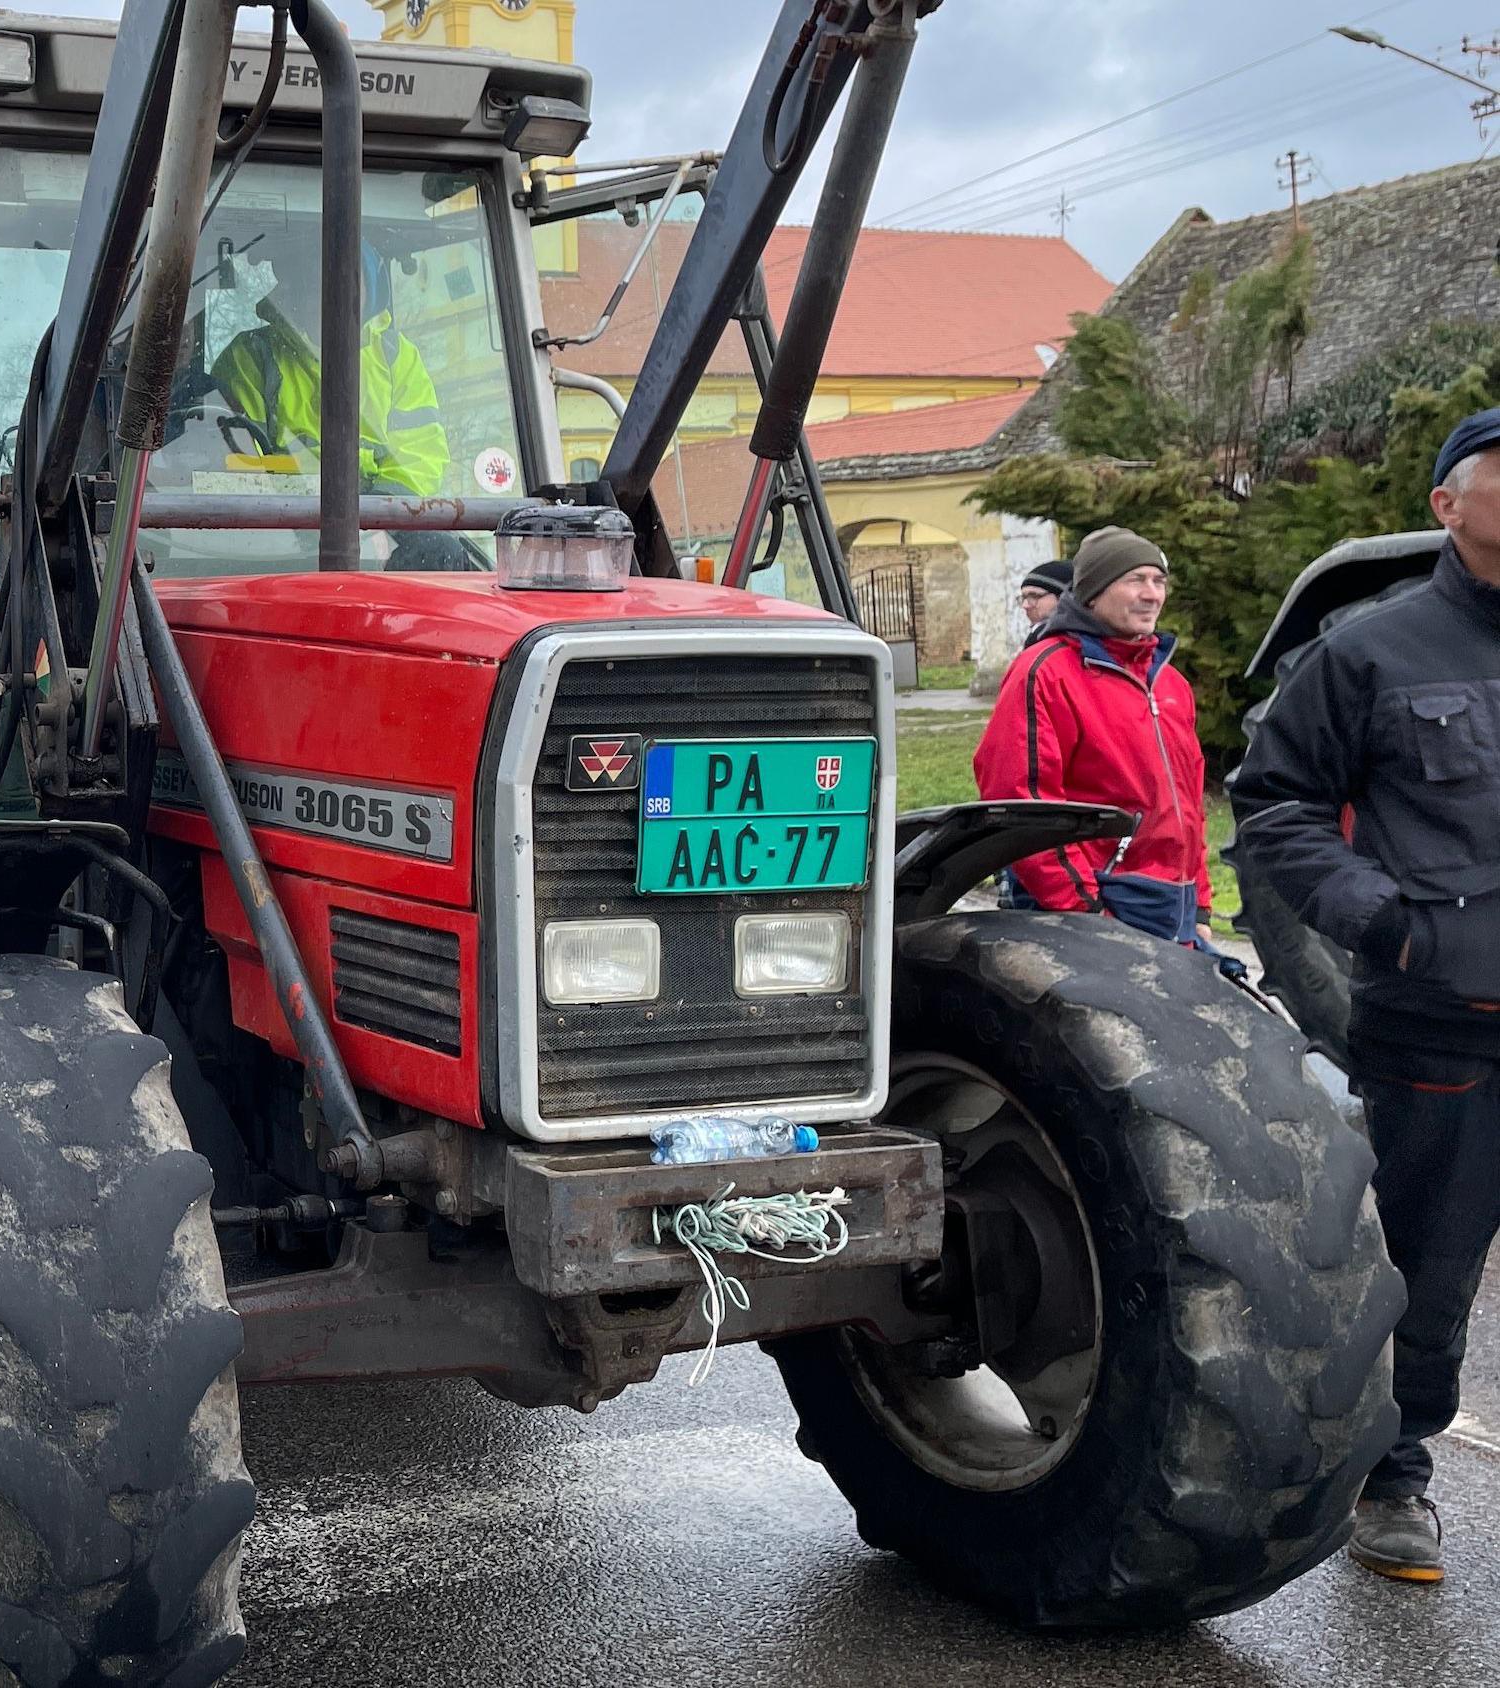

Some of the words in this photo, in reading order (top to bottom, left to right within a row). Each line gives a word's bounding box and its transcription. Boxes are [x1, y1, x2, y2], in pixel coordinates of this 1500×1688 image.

[283, 65, 415, 95] ERSON
[706, 752, 765, 811] PA
[295, 786, 393, 838] 3065
[405, 803, 432, 845] S
[647, 797, 672, 814] SRB
